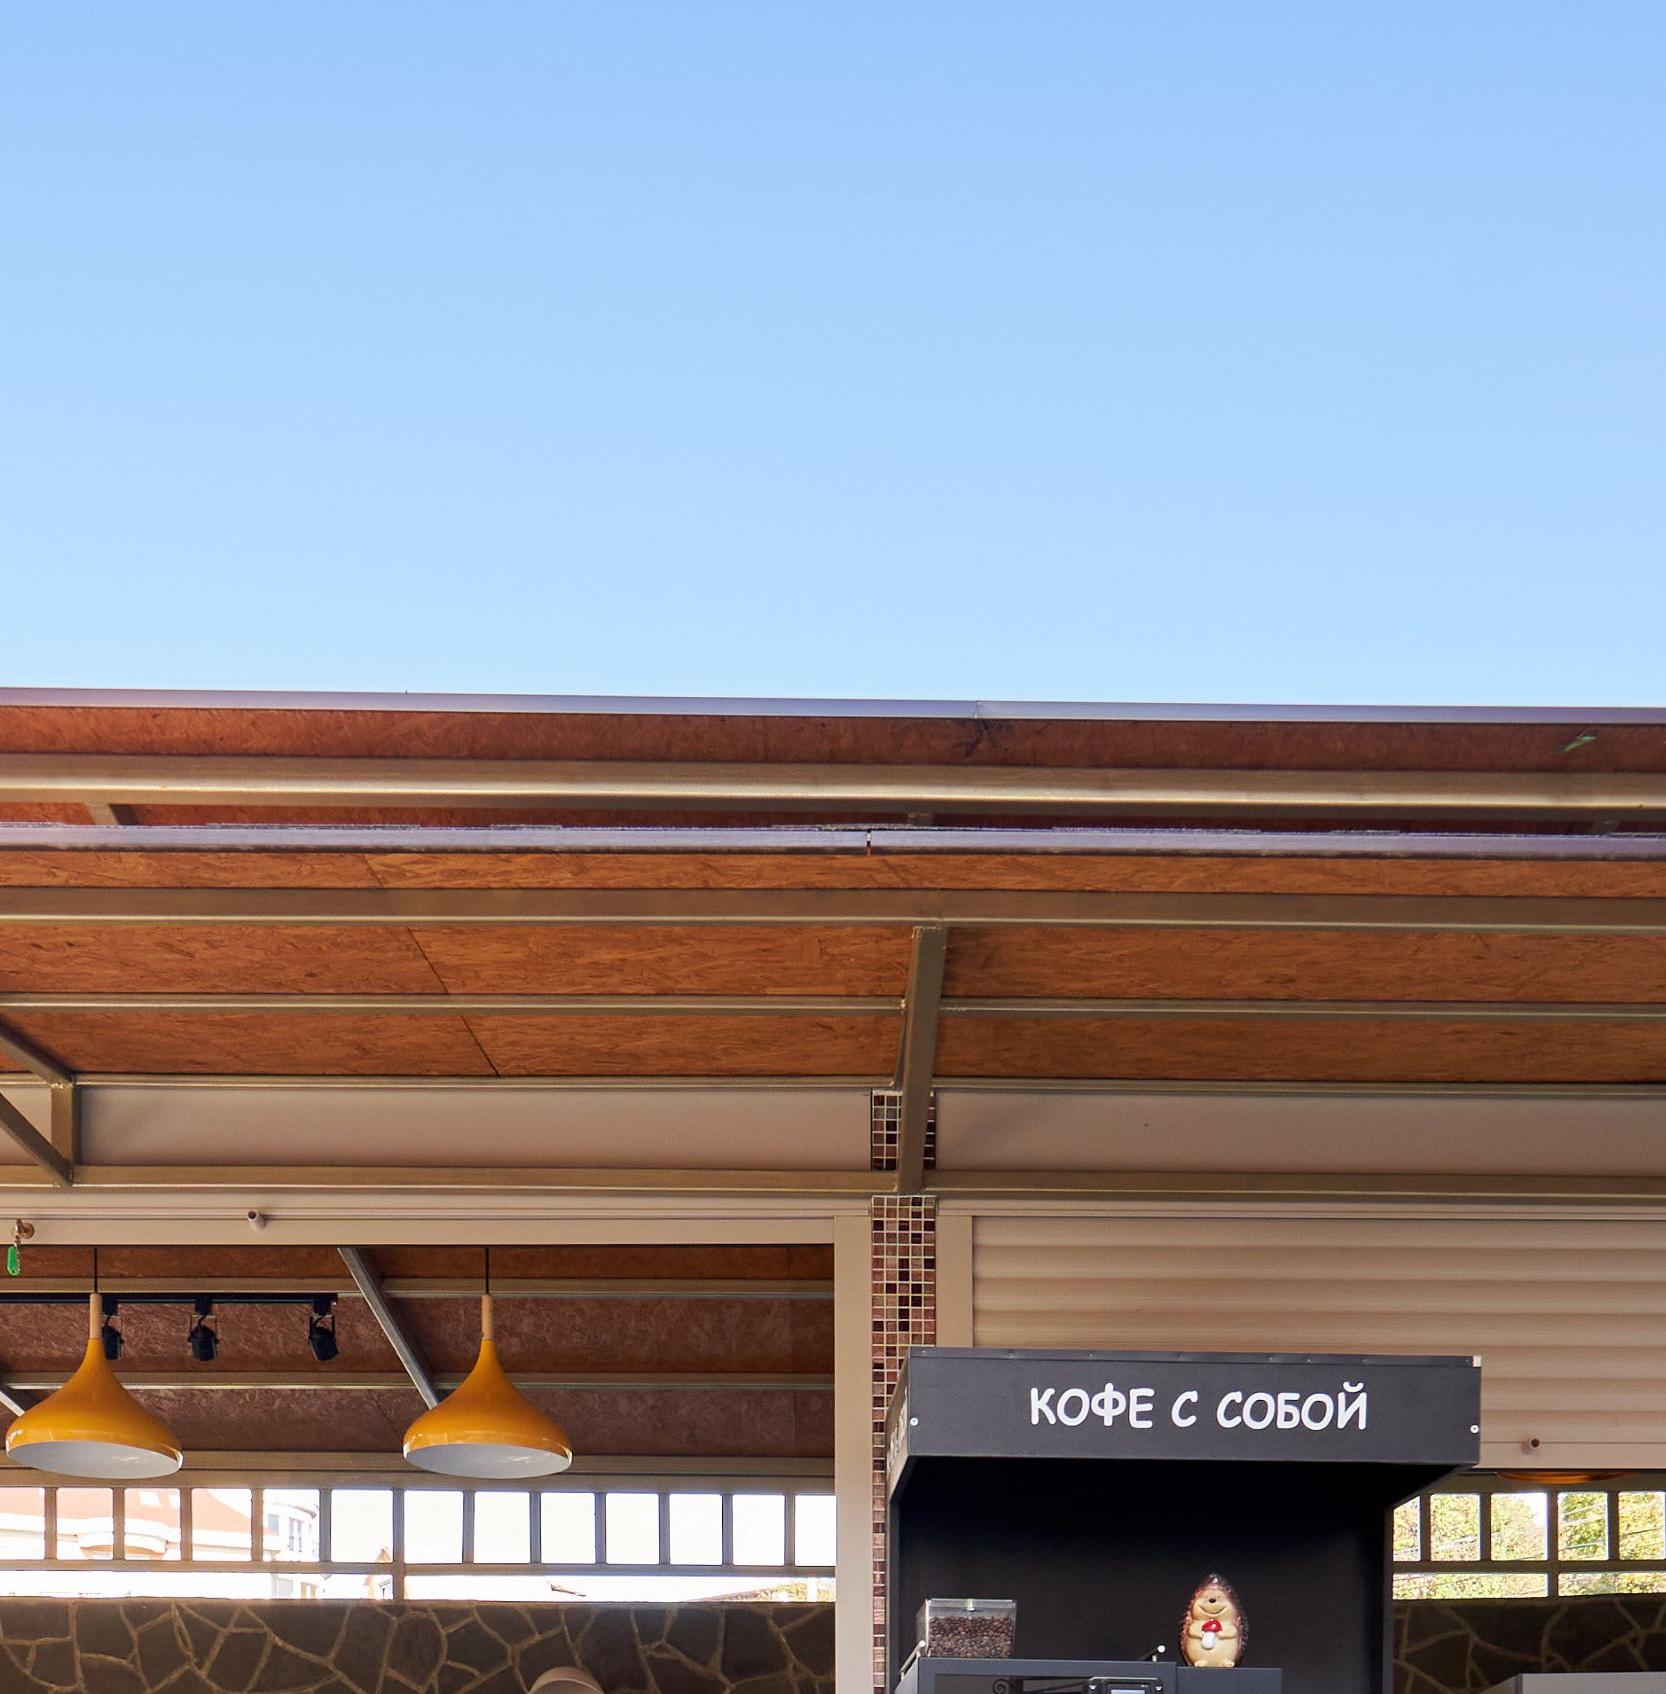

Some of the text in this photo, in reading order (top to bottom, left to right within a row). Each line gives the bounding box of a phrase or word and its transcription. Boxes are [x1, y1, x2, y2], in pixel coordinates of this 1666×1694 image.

[1030, 1381, 1367, 1430] КОФЕ С СОБОЙ
